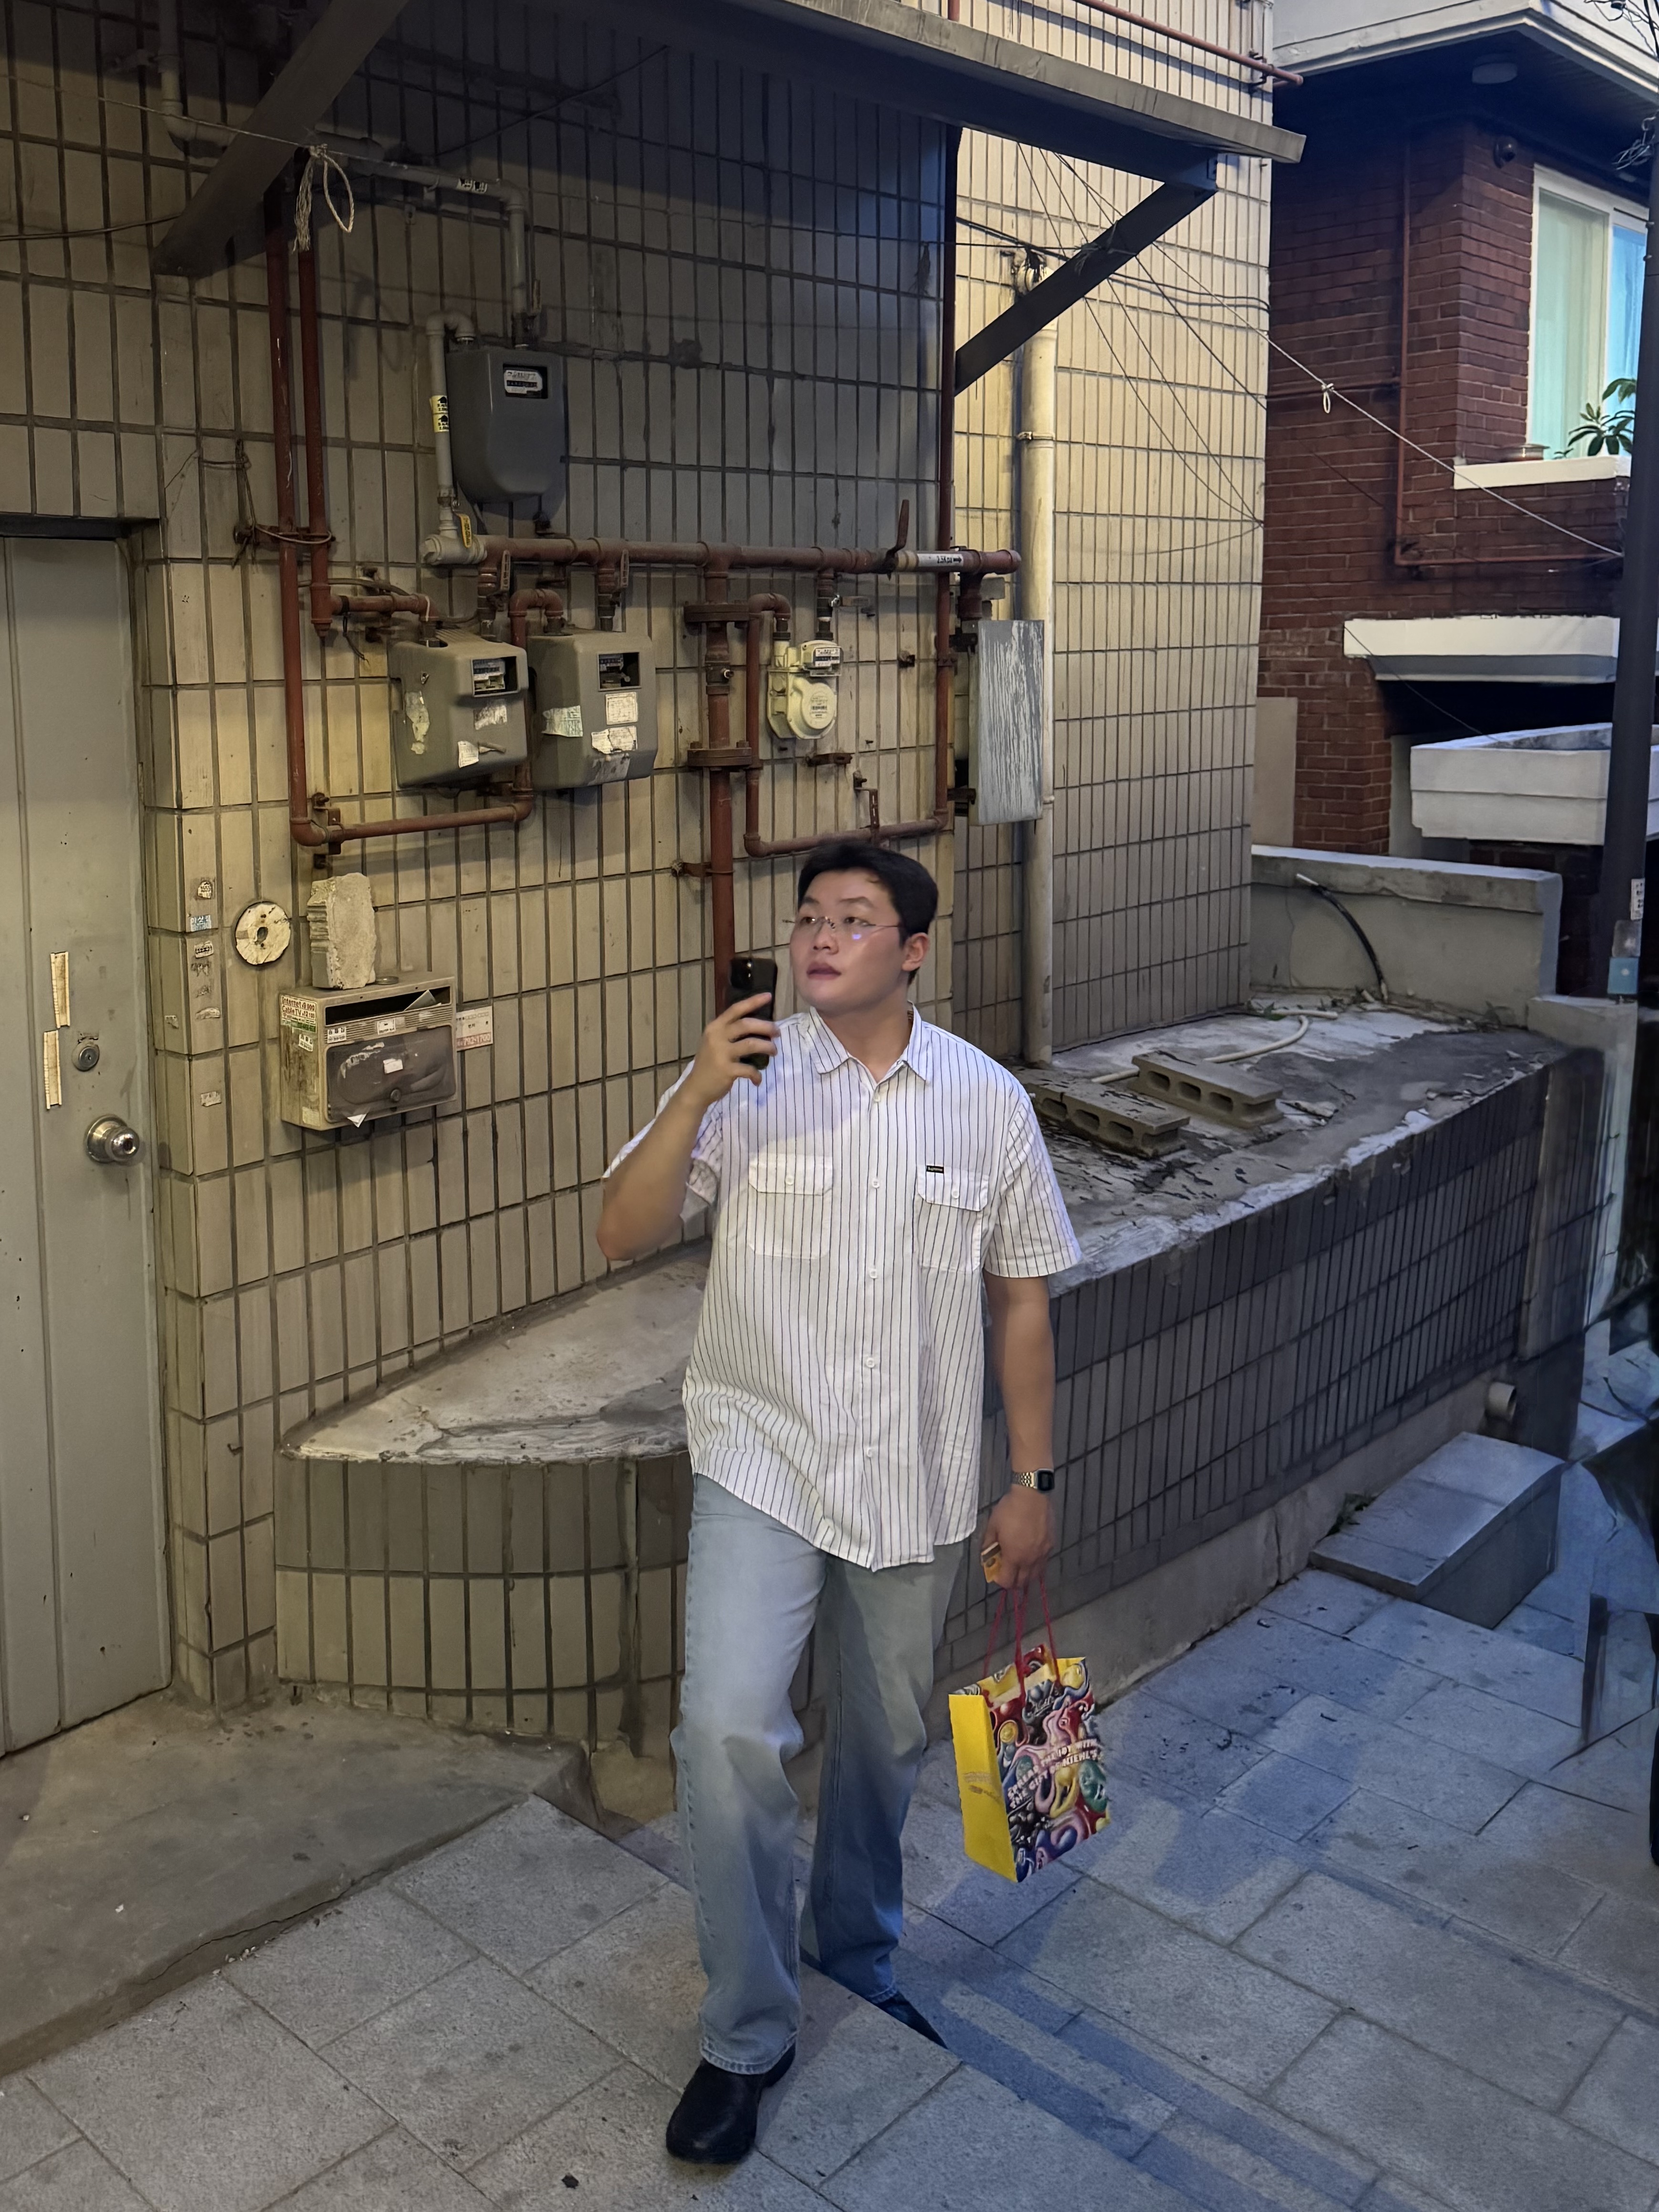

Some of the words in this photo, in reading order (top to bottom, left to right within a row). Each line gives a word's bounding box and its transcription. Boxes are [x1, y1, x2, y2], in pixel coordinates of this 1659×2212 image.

[282, 997, 301, 1008] Internet
[282, 1005, 295, 1014] Cable
[295, 1008, 302, 1017] TV
